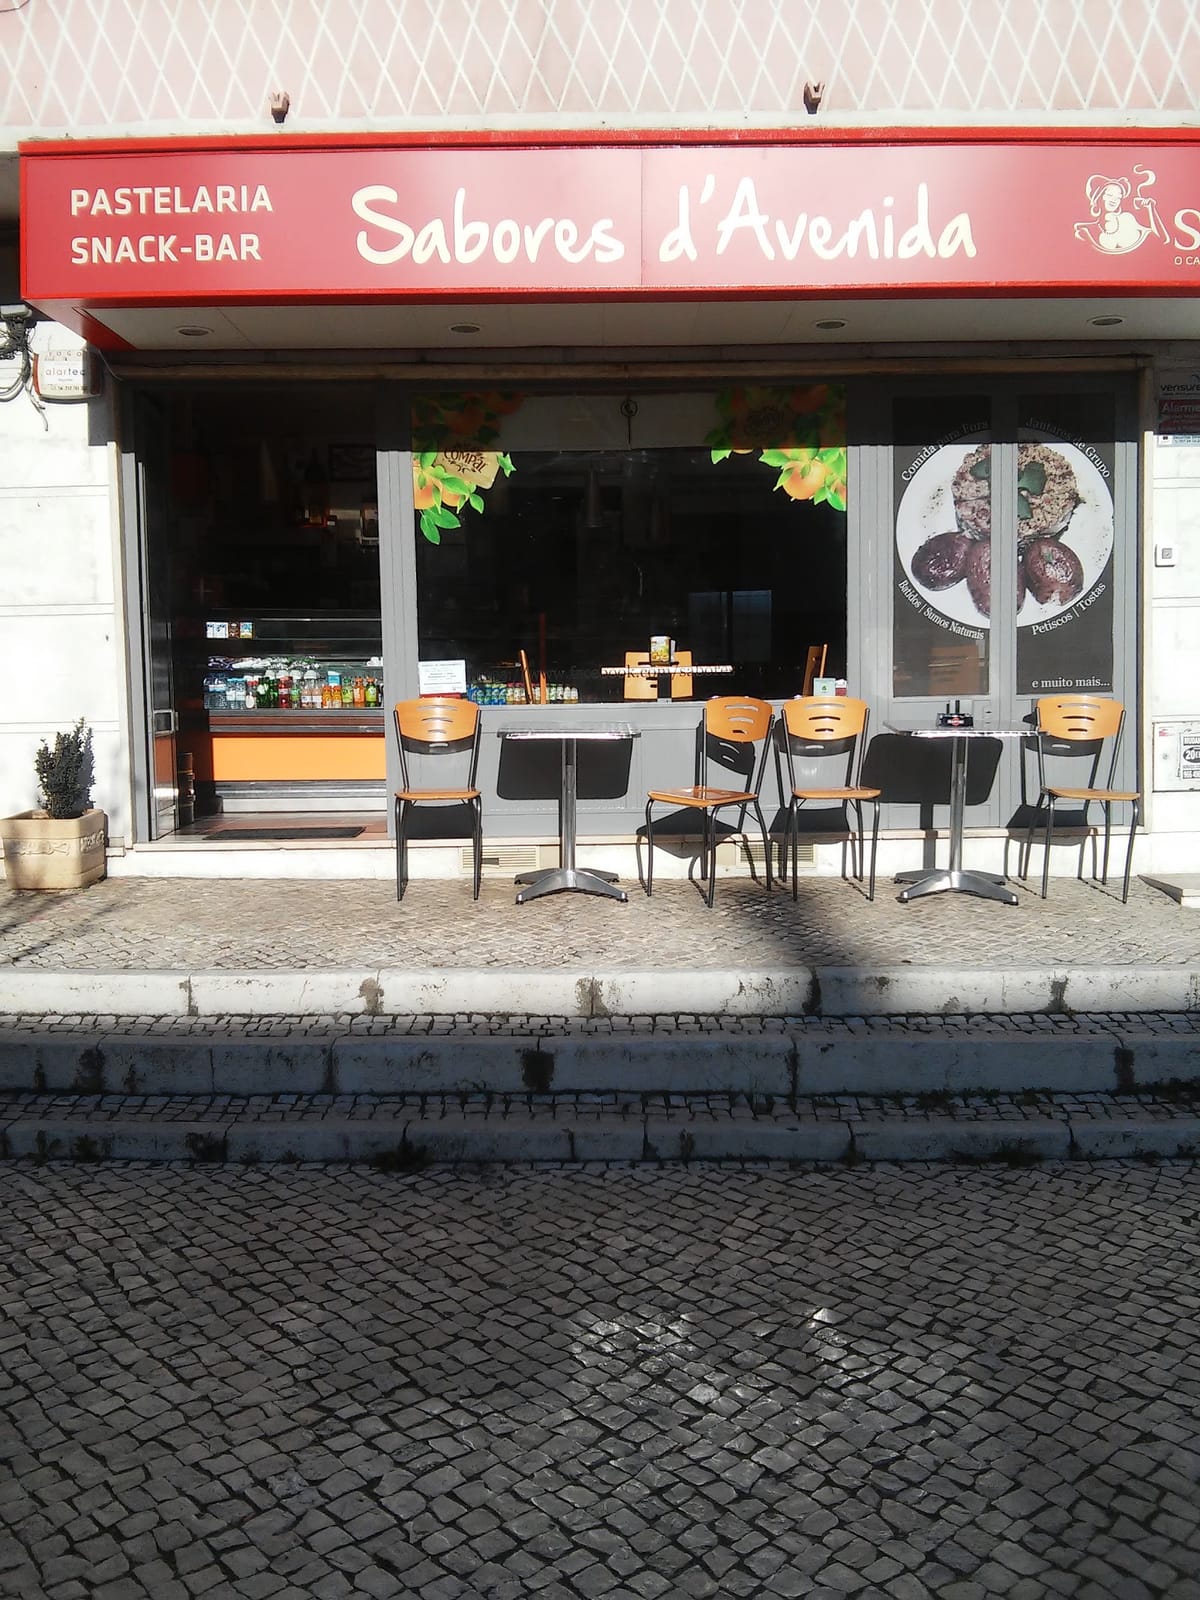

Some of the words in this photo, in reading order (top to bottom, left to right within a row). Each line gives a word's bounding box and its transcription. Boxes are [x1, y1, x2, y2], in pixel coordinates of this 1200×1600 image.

[70, 184, 274, 217] PASTELARIA
[351, 184, 626, 266] Sabores
[658, 173, 978, 263] d'Avenida
[70, 232, 262, 264] SNACK-BAR
[901, 444, 937, 481] Comida
[1072, 436, 1086, 450] de
[1085, 445, 1111, 478] Grupo
[898, 579, 922, 608] Batidos
[923, 606, 950, 629] Sumos
[948, 620, 985, 640] Naturais
[1031, 611, 1074, 636] Petiscos
[1076, 582, 1107, 611] Tostas
[1031, 680, 1039, 688] e
[1040, 677, 1073, 688] muito
[1075, 675, 1111, 688] mais...
